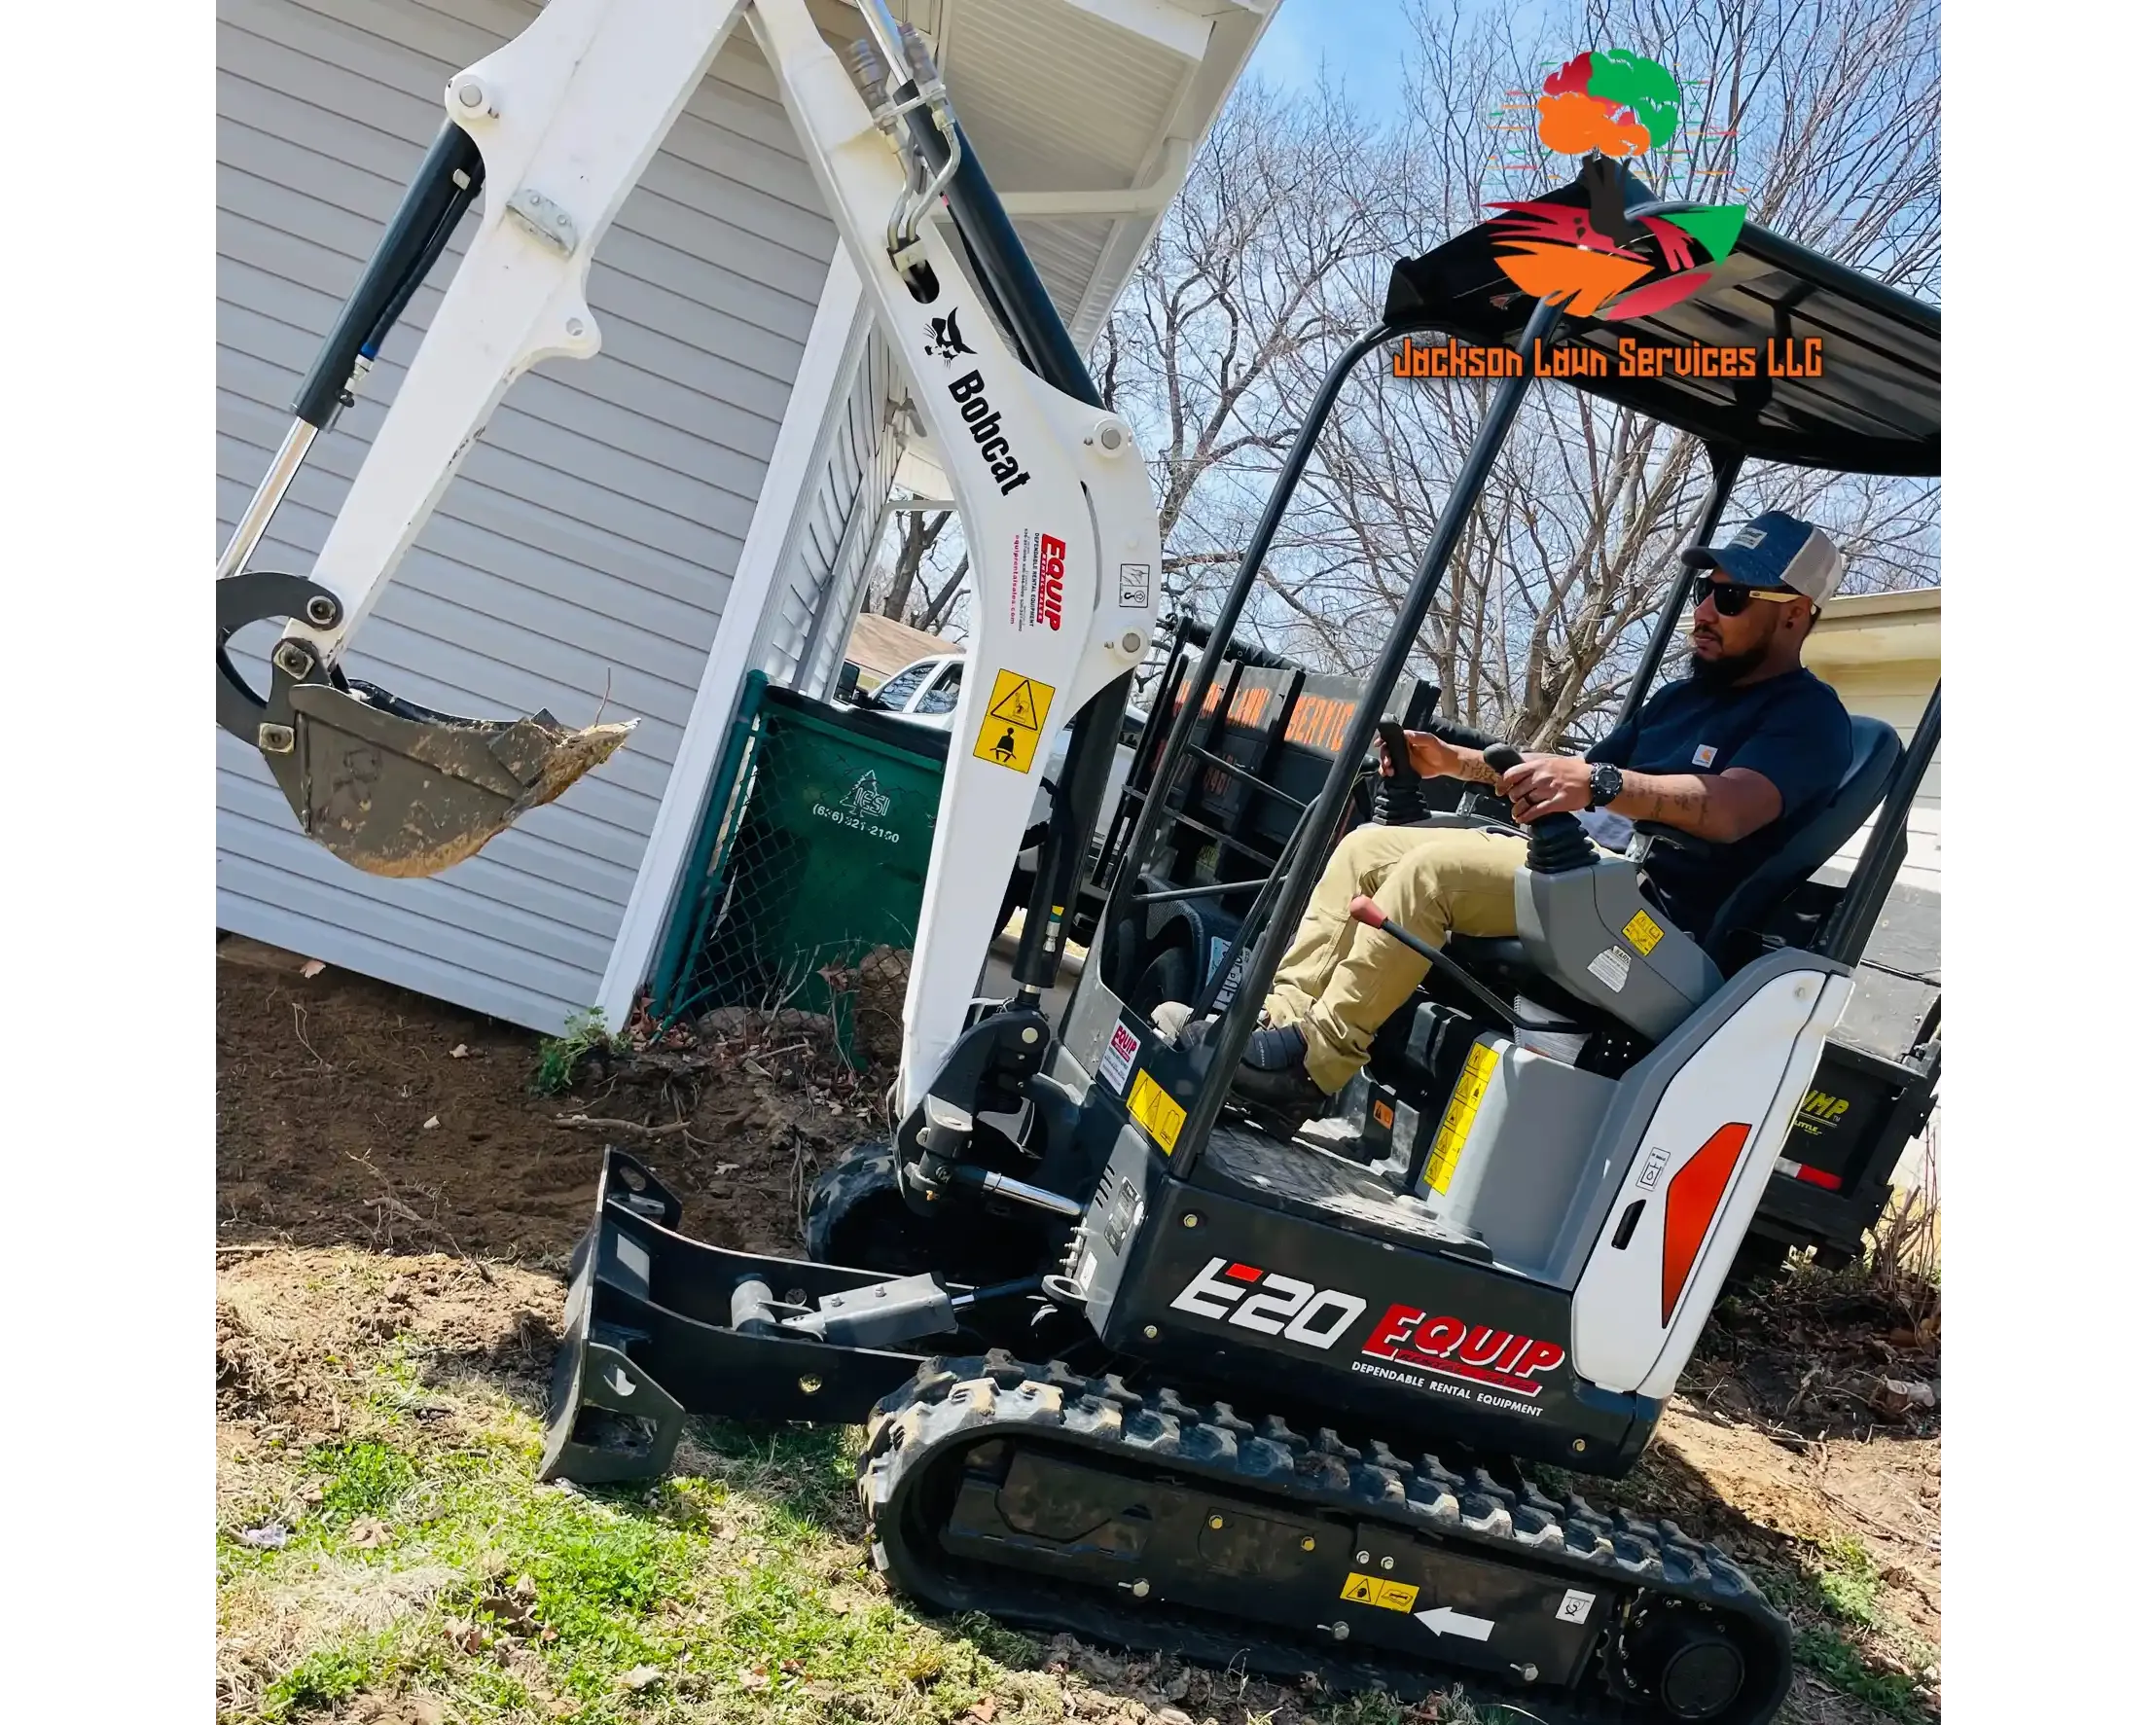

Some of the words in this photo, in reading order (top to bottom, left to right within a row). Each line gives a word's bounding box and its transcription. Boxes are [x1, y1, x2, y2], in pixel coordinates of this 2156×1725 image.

[948, 370, 1031, 497] Bobcat
[1041, 533, 1066, 631] EQUIP
[1112, 1024, 1137, 1055] EQUIP
[1170, 1257, 1367, 1349] E20
[1361, 1303, 1565, 1378] EQUIP
[1351, 1361, 1425, 1388] DEPENDABLE
[1429, 1381, 1471, 1399] RENTAL
[1476, 1393, 1543, 1418] EQUIPMENT
